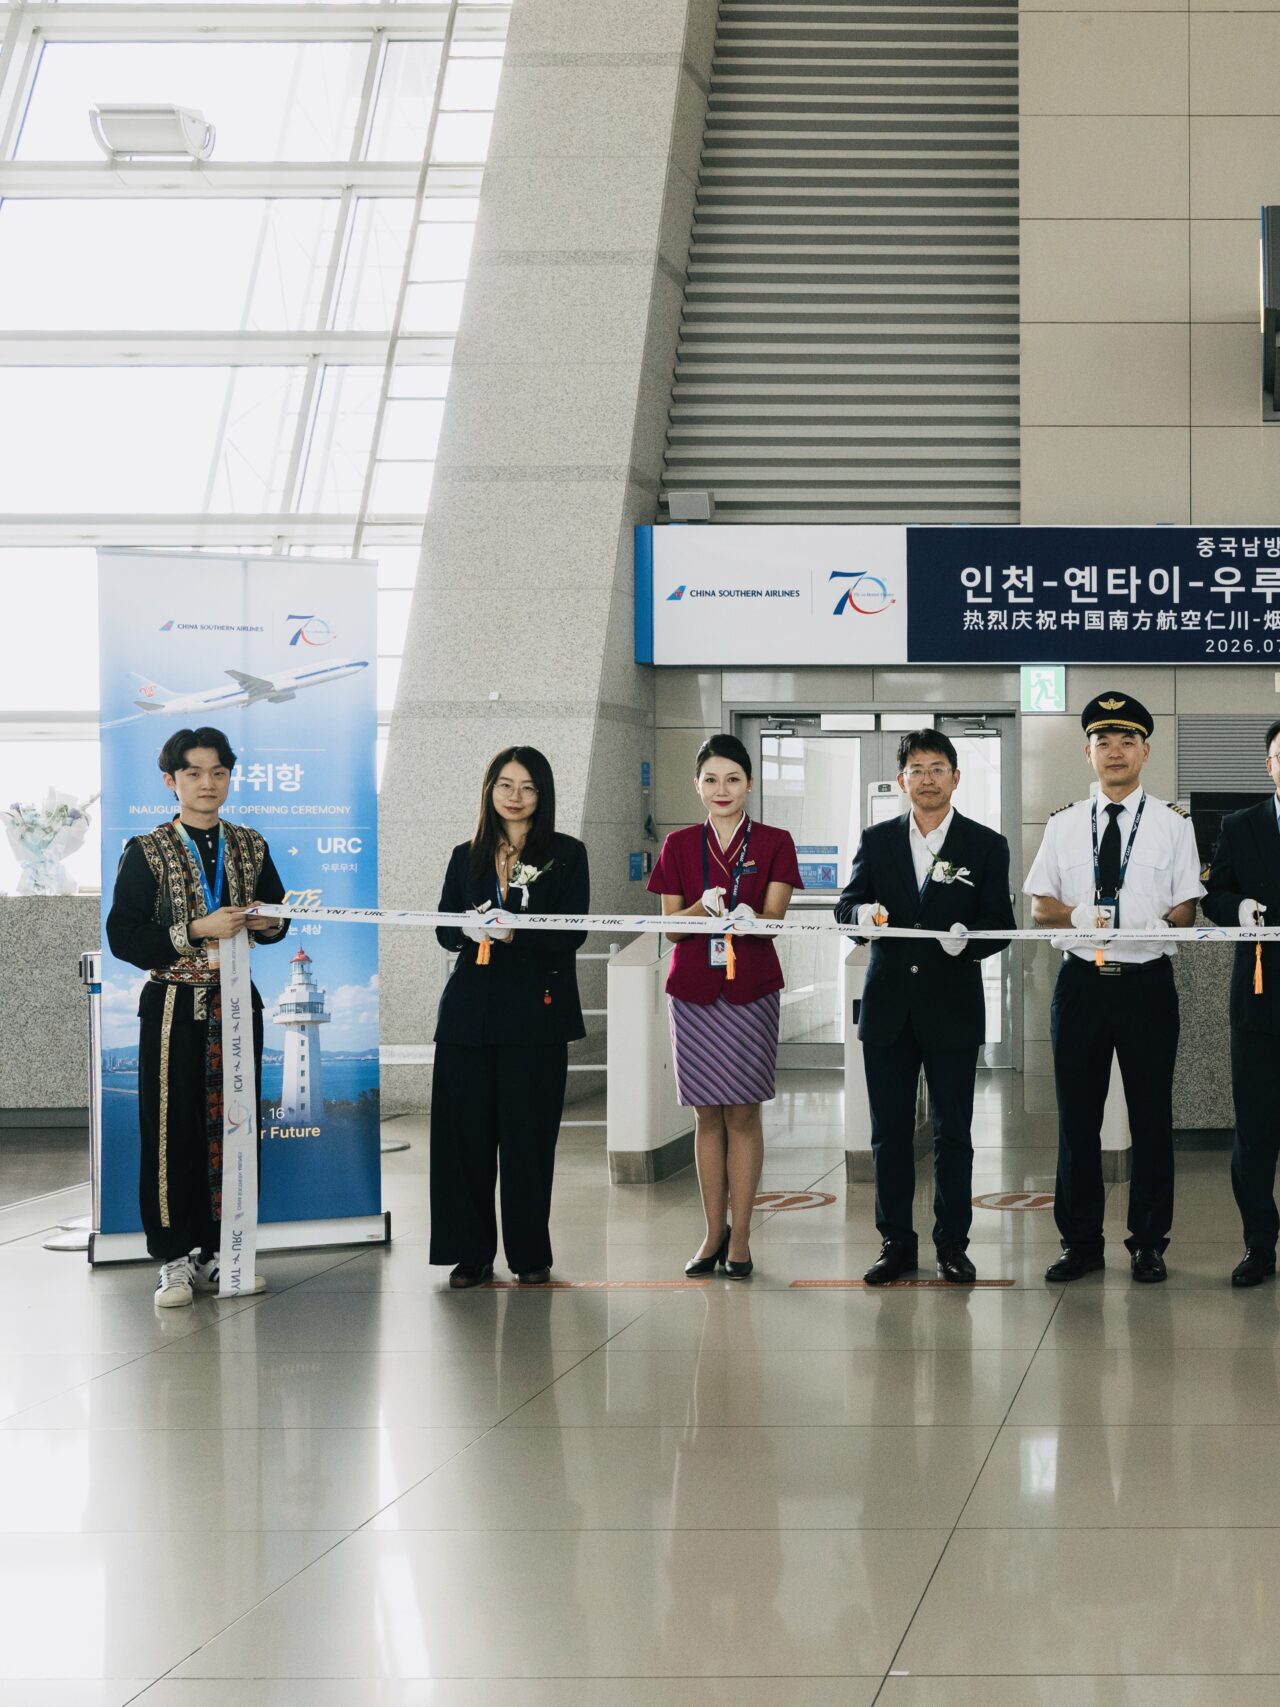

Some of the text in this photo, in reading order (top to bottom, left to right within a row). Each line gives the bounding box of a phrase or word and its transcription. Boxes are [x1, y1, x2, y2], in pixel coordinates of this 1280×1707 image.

[689, 588, 801, 599] CHINA SOUTHERN AIRLINES
[230, 763, 304, 792] 취항
[240, 805, 290, 815] OPENING
[291, 805, 353, 815] CEREMONY
[317, 837, 362, 855] URC
[268, 1107, 285, 1120] 16
[270, 1126, 321, 1139] Future
